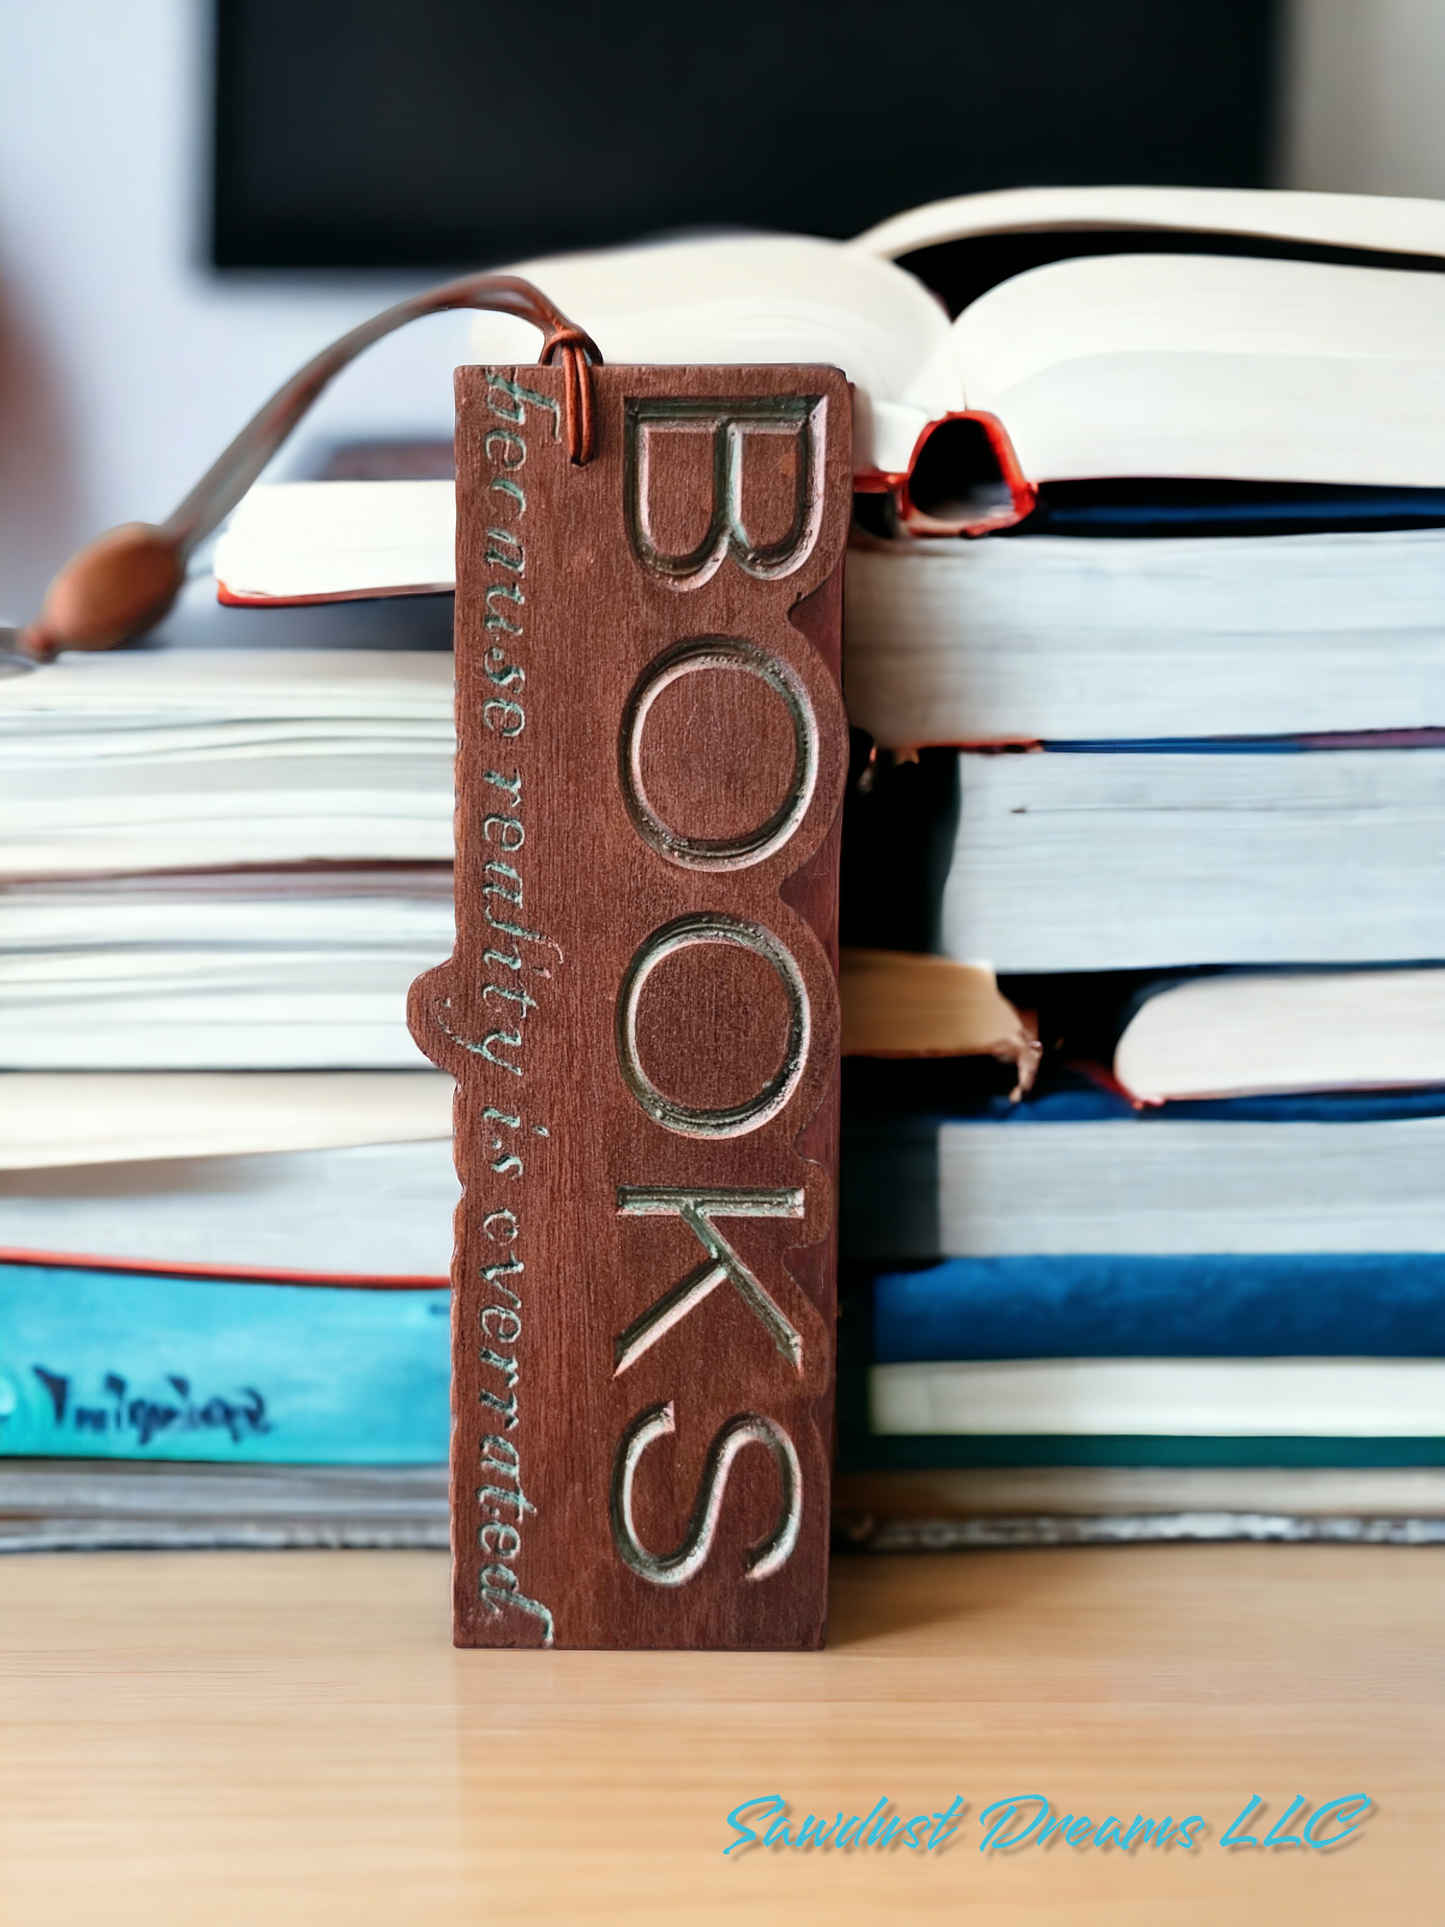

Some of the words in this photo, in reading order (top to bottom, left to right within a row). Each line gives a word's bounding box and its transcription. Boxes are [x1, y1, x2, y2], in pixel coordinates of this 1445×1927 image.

[483, 366, 562, 738] because
[436, 769, 564, 1077] reality
[614, 394, 828, 1588] BOOKS
[482, 1106, 550, 1181] is
